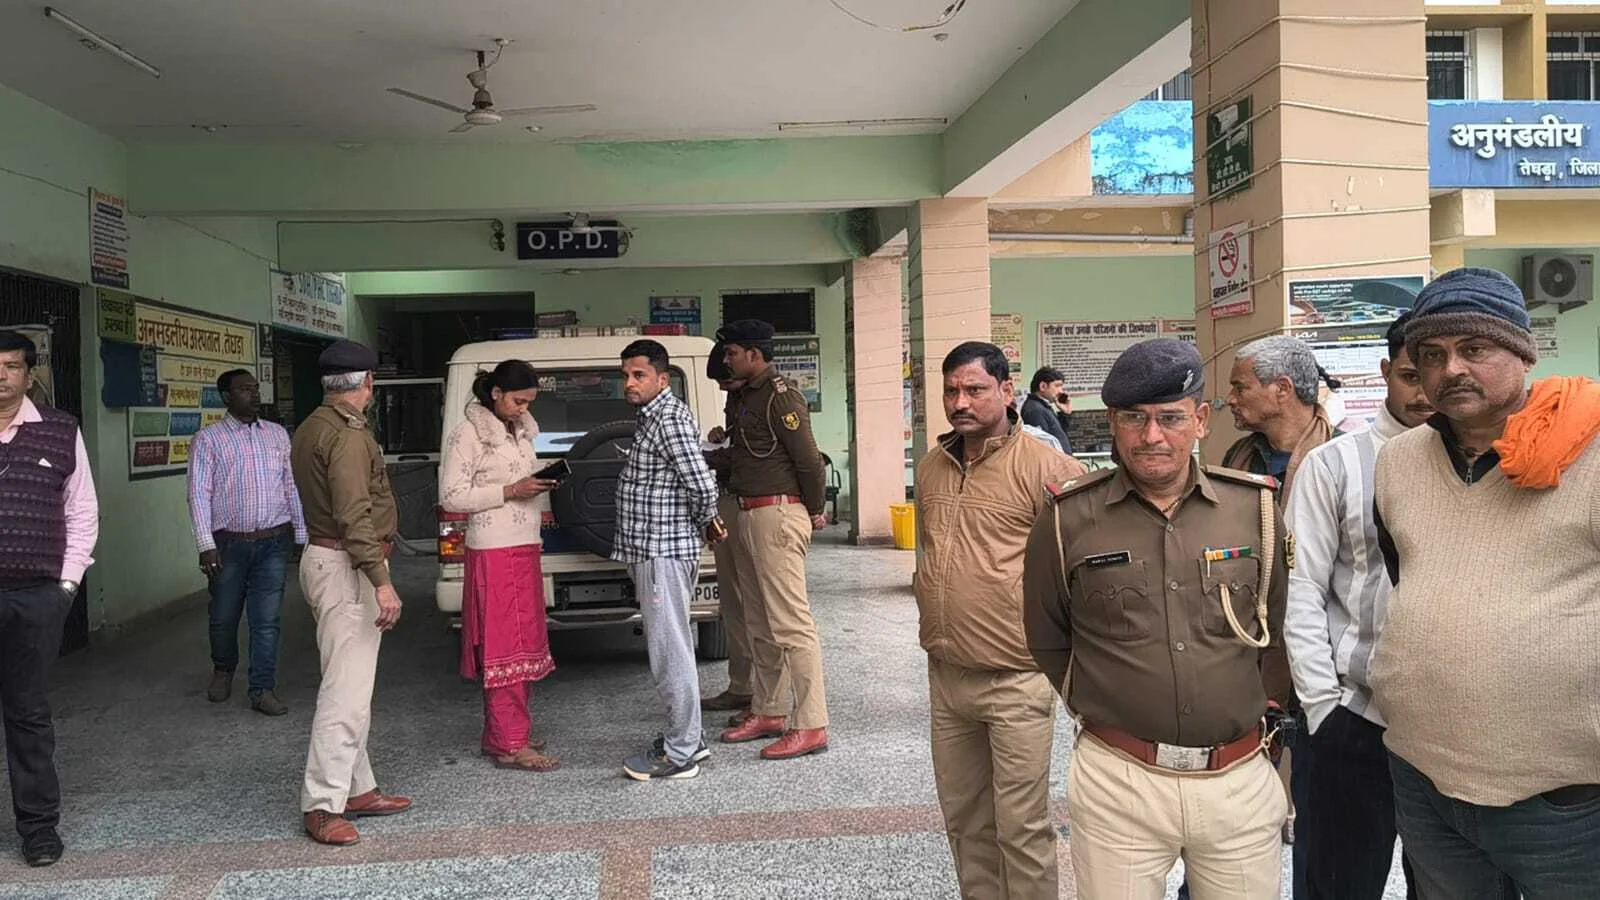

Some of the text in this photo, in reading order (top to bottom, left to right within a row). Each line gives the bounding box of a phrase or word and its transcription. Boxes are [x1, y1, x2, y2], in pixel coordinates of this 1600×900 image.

[1451, 114, 1584, 159] अनुमंडलीय
[528, 230, 608, 250] O.P.D.
[138, 316, 189, 350] अनुमंडलीय
